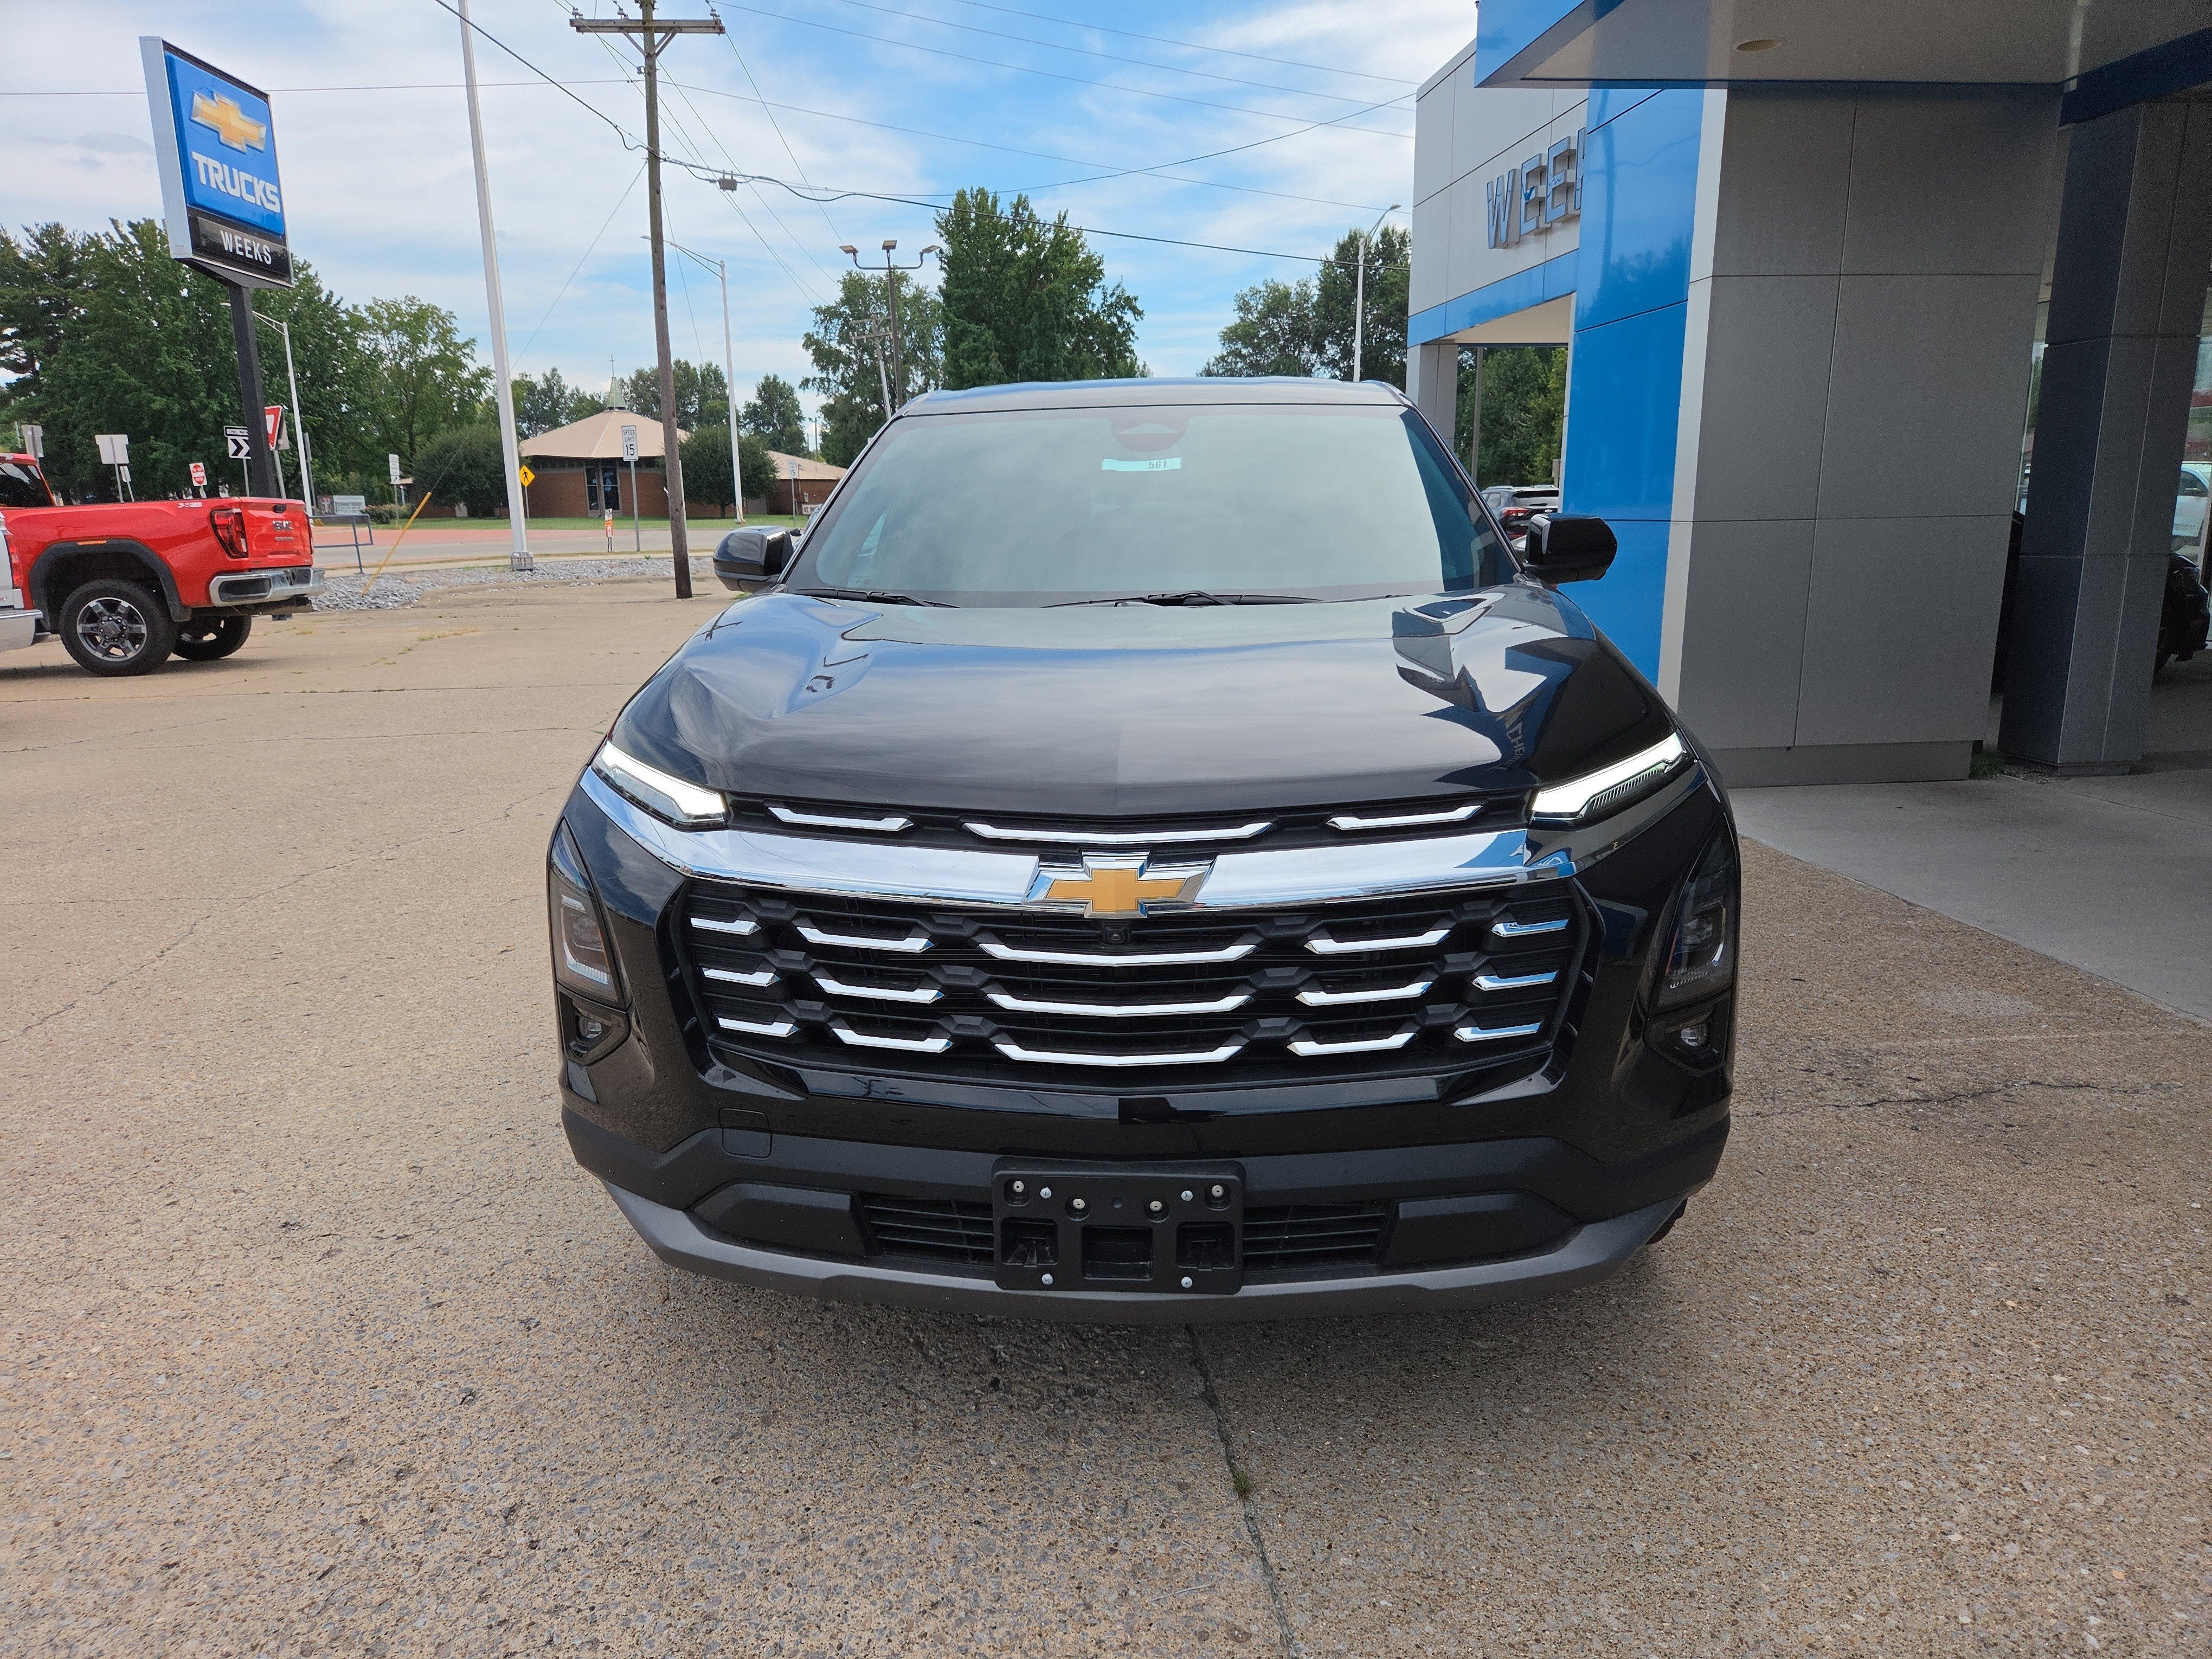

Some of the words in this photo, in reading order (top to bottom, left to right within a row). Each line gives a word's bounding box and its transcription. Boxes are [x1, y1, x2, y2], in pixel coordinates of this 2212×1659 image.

[191, 151, 280, 214] TRUCKS
[220, 229, 272, 265] WEEKS
[626, 443, 635, 456] 15
[1148, 461, 1166, 469] 561
